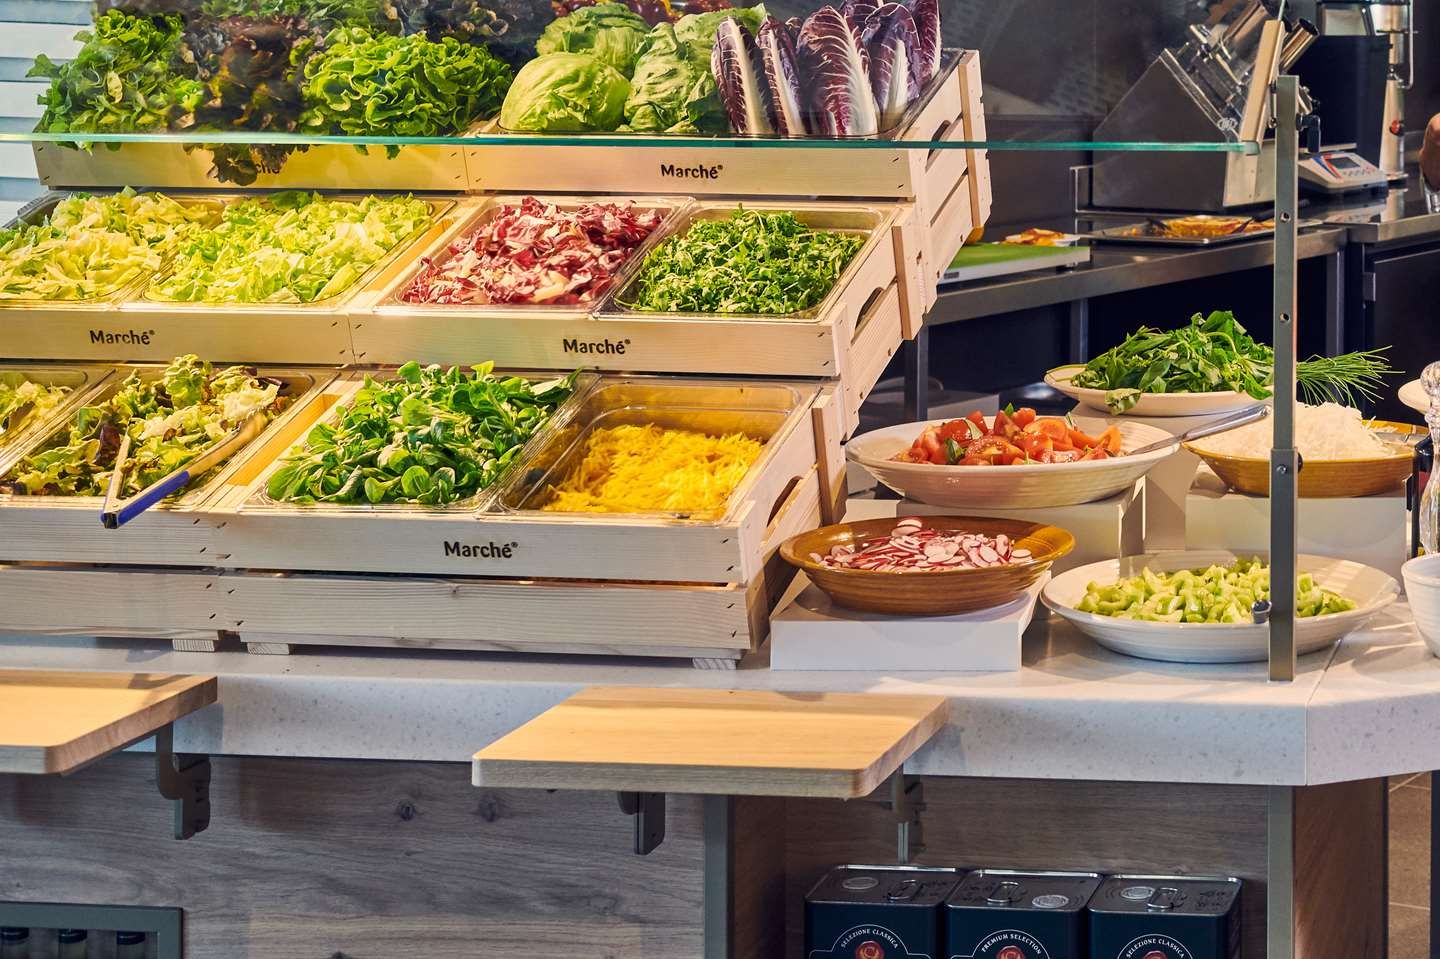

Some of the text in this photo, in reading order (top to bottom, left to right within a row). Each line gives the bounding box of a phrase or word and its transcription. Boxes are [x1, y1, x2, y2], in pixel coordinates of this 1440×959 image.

[841, 928, 898, 949] SELEZIONE CLASSICA
[981, 933, 1041, 954] PREMIUM SELECTION
[1126, 938, 1185, 958] SELEZIONE CLASSICA
